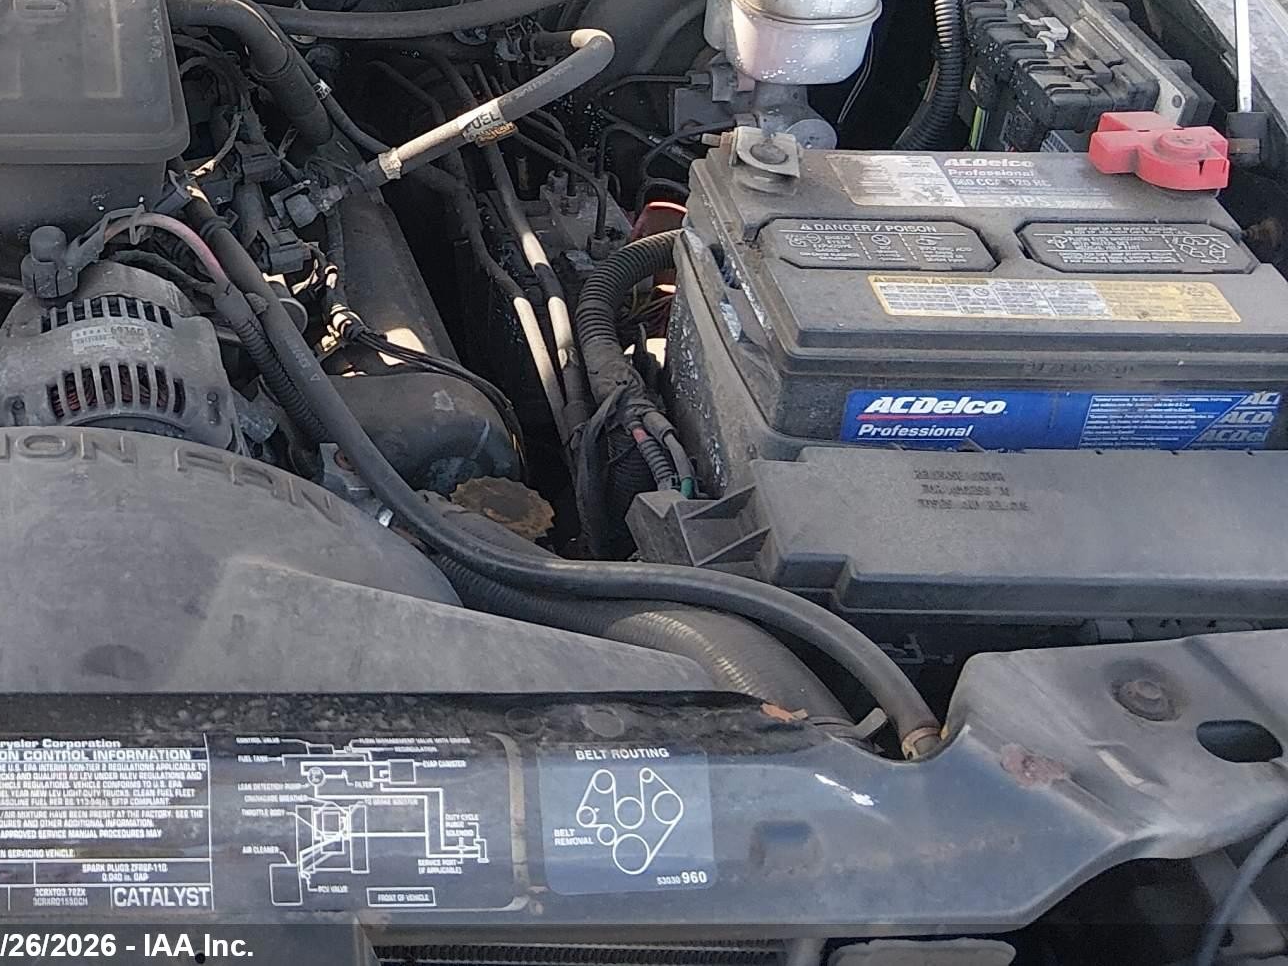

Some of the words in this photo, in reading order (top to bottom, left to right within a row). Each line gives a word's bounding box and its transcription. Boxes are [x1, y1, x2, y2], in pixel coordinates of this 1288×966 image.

[943, 158, 1034, 168] ACDelco
[948, 169, 1034, 178] Professional
[813, 223, 870, 232] DANGER
[863, 396, 1003, 414] ACDelco
[858, 424, 973, 438] Professional
[174, 446, 344, 526] FAN
[42, 738, 120, 749] Corporation
[23, 751, 89, 761] CONTROL
[93, 750, 191, 760] INFORMATION
[575, 750, 606, 760] BELT
[612, 748, 670, 758] ROUTING
[554, 837, 594, 845] REMOVAL
[682, 871, 707, 884] 960
[114, 888, 210, 906] CATALYST
